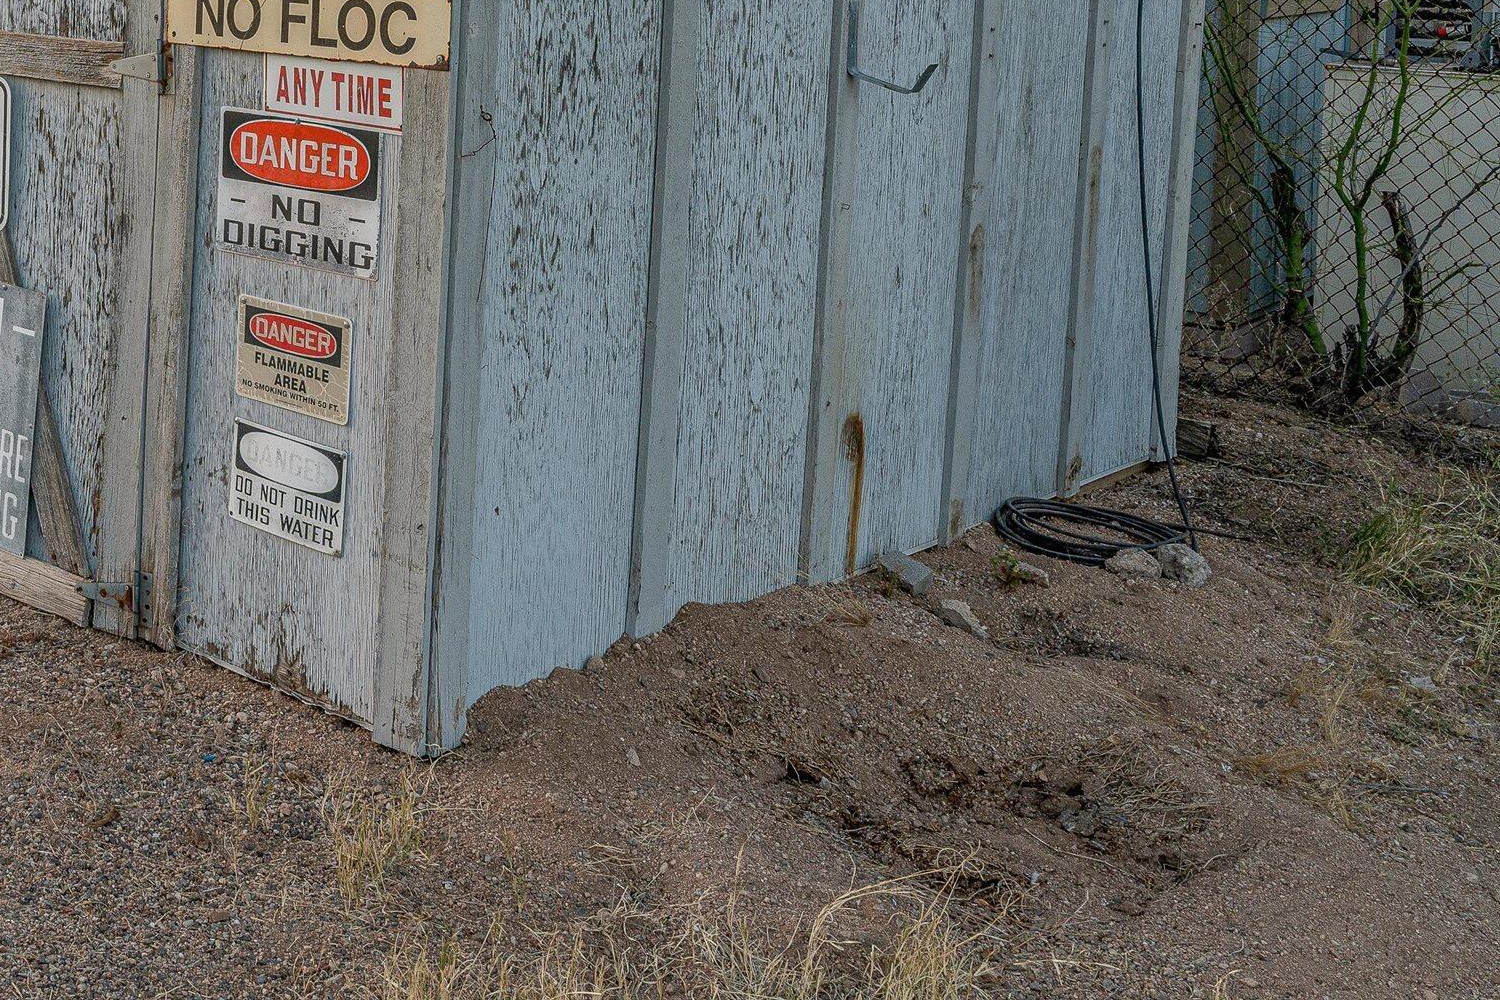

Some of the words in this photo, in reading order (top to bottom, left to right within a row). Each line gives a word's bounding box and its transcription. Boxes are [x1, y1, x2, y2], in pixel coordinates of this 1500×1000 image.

[240, 131, 358, 180] DANGER
[271, 194, 321, 226] NO
[223, 218, 374, 270] DIGGING
[255, 317, 331, 354] DANGER
[255, 351, 329, 383] FLAMMABLE
[274, 373, 307, 394] AREA
[242, 379, 252, 388] NO
[254, 382, 288, 398] SMOKING
[289, 391, 315, 406] WITHIN
[318, 400, 327, 409] 50
[235, 474, 252, 496] DO
[260, 484, 287, 508] NOT
[294, 495, 340, 527] DRINK
[237, 497, 270, 526] THIS
[280, 513, 334, 549] WATER
